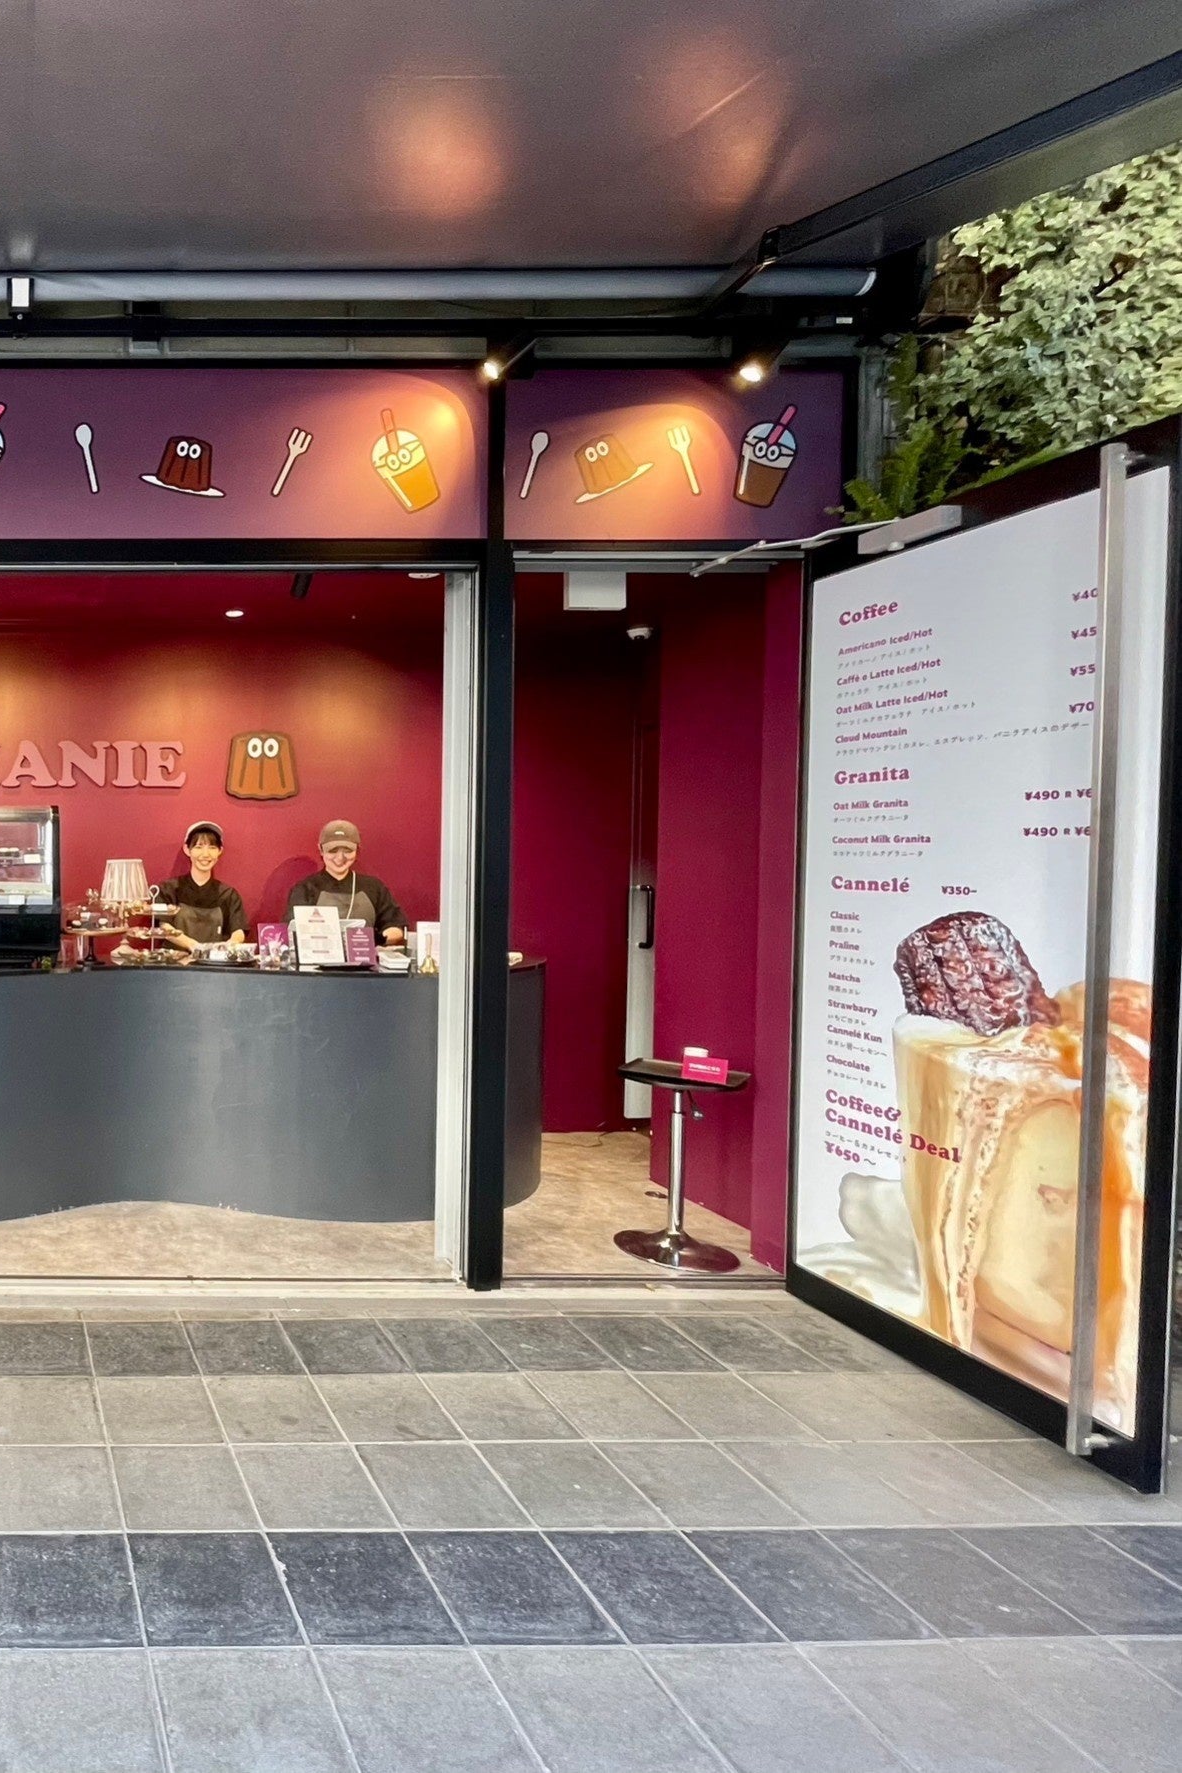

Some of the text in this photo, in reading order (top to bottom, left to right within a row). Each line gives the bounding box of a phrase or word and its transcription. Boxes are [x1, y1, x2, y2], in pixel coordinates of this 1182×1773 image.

[839, 601, 898, 626] Coffee
[838, 628, 933, 656] Americano Iced/Hot
[870, 668, 895, 680] Latte
[897, 658, 941, 674] Iced/Hot
[836, 689, 948, 715] Oat Milk Latte Iced/Hot
[835, 727, 908, 744] Cloud Mountain
[834, 767, 910, 786] Granita
[1024, 790, 1060, 801] ¥490
[833, 799, 909, 811] Oat Milk Granita
[832, 834, 931, 844] Coconut Milk Granita
[1023, 826, 1058, 837] ¥490
[831, 875, 910, 893] Cannelé
[830, 911, 860, 921] Classic
[829, 940, 860, 951] Praline
[828, 971, 861, 983] Matcha
[827, 1024, 882, 1043] Cannelé Kun
[826, 1054, 870, 1072] Chocolate
[825, 1089, 902, 1122] Coffee&
[825, 1108, 963, 1163] Cannelé Deal
